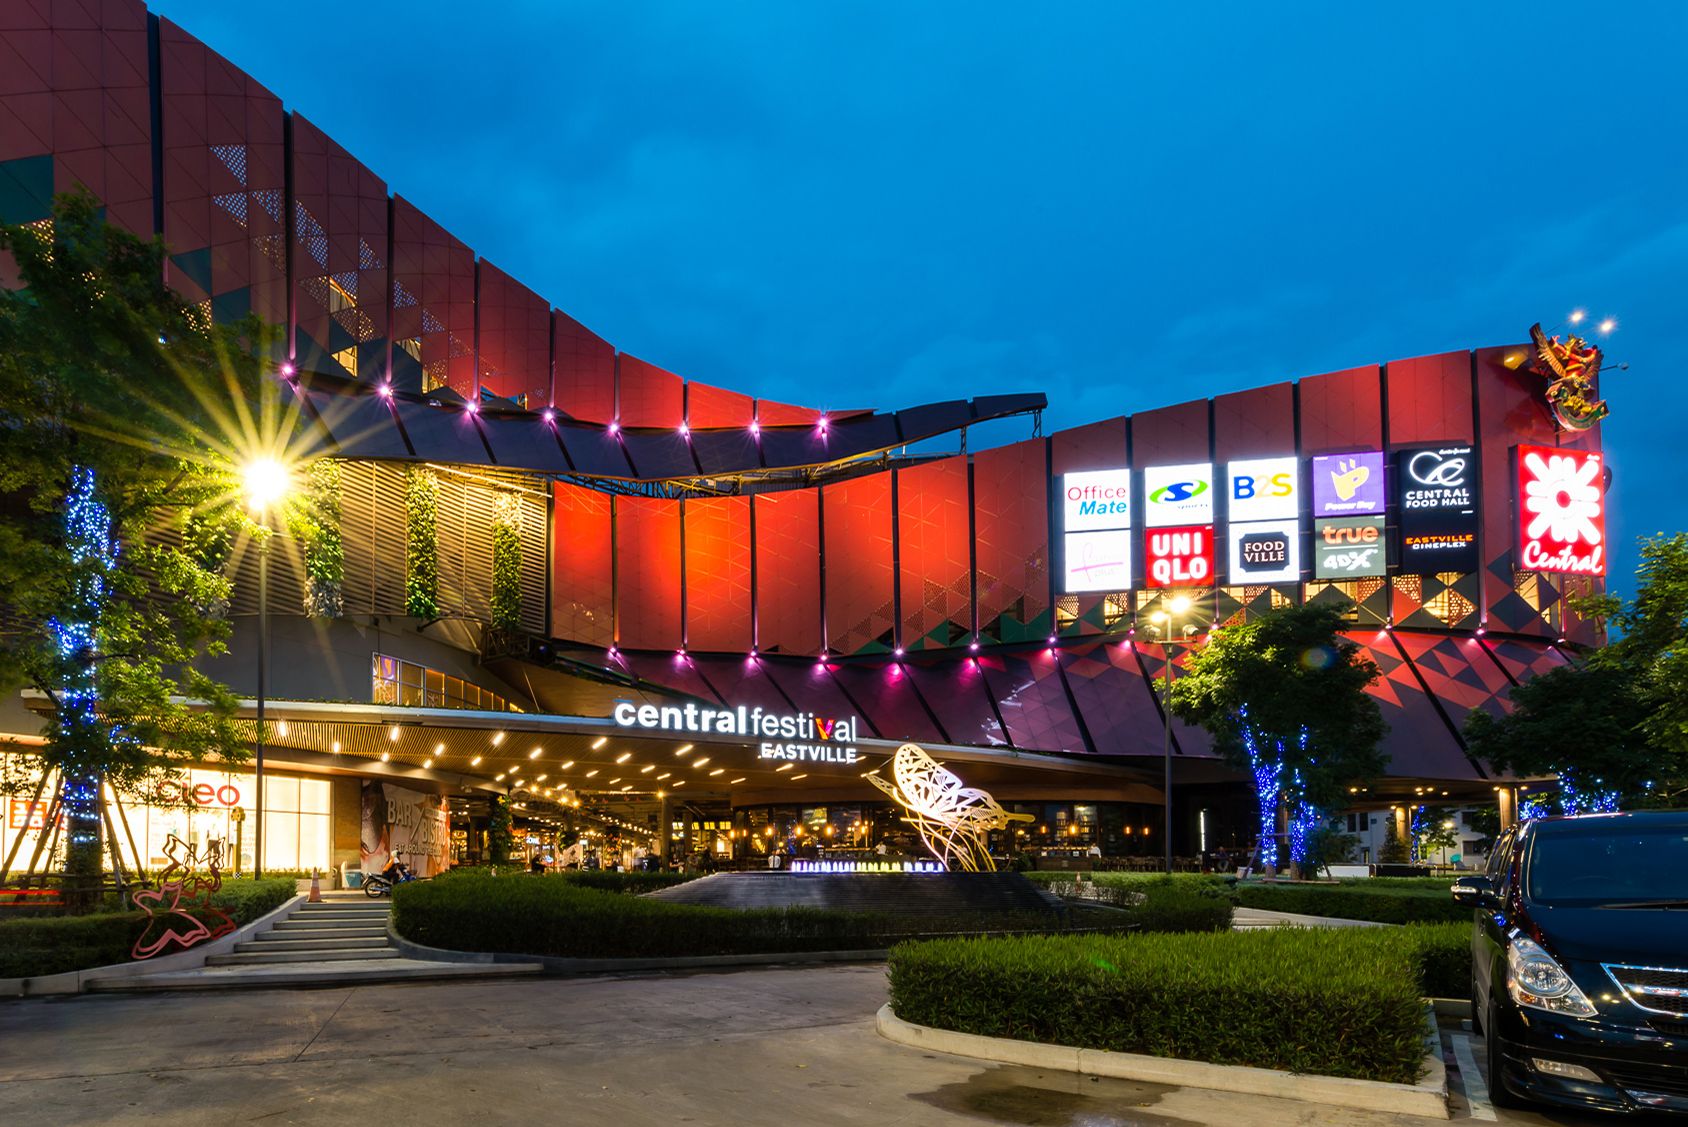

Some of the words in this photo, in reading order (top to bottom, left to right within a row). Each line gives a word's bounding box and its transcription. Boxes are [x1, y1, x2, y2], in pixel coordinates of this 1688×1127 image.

[1067, 484, 1126, 501] Office
[1233, 472, 1293, 500] B2S
[1405, 488, 1470, 500] CENTRAL
[1079, 500, 1127, 516] Mate
[1405, 499, 1438, 508] FOOD
[1441, 497, 1470, 506] HALL
[1152, 531, 1203, 556] UNI
[1322, 525, 1379, 544] true
[1405, 534, 1473, 545] EASTVILLE
[1244, 540, 1285, 552] FOOD
[1243, 551, 1285, 563] VILLE
[1323, 549, 1379, 571] 4DX
[1523, 540, 1603, 573] Central
[1152, 557, 1208, 584] QLO
[761, 743, 857, 763] EASTVILLE
[387, 799, 412, 827] BAR
